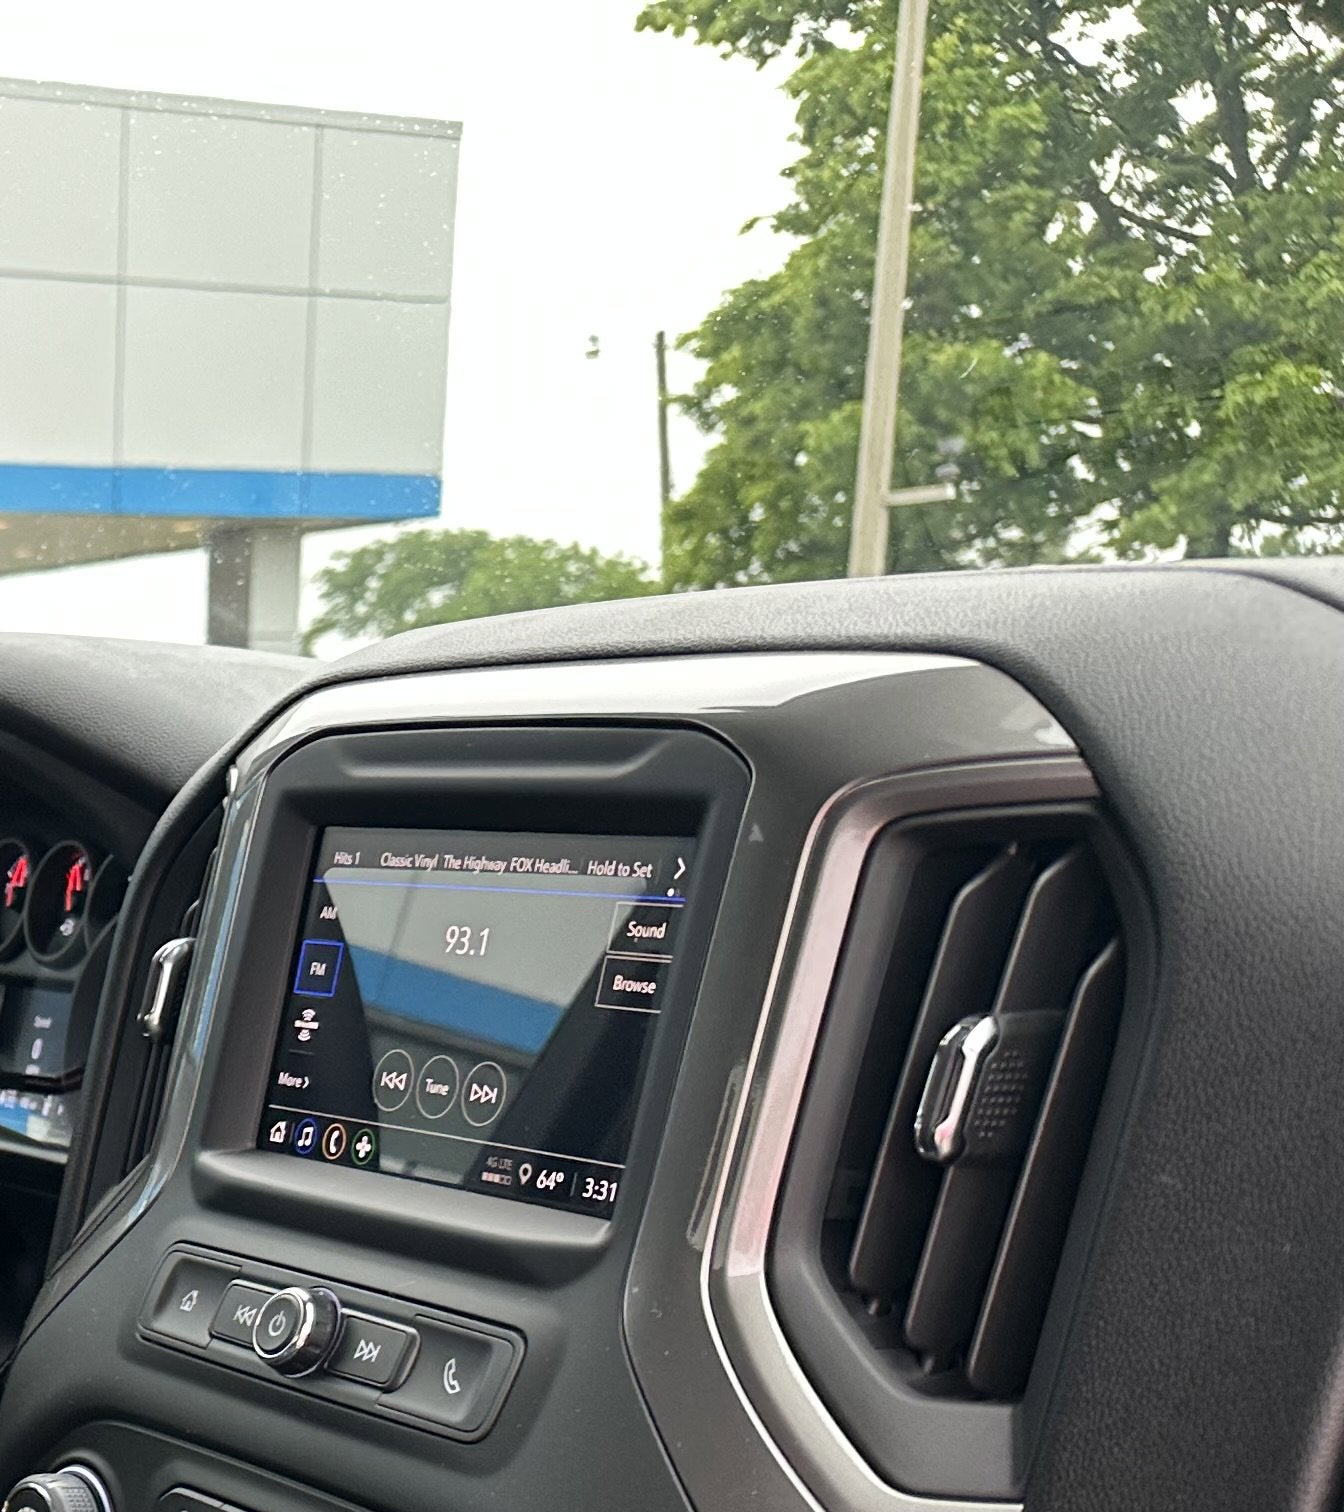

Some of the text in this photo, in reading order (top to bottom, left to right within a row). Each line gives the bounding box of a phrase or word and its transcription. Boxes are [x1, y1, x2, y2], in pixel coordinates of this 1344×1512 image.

[333, 851, 361, 865] Hits 1
[380, 852, 438, 871] Classic Vinyl
[443, 854, 507, 875] The Highway
[510, 857, 533, 872] FOX
[587, 860, 653, 878] Hold to Set
[319, 906, 337, 920] AM
[626, 921, 667, 939] Sound
[444, 925, 491, 956] 93.1
[310, 961, 326, 976] FM
[612, 974, 657, 994] Browse
[278, 1072, 303, 1087] More
[425, 1078, 450, 1096] Tune
[581, 1177, 618, 1202] 3:31
